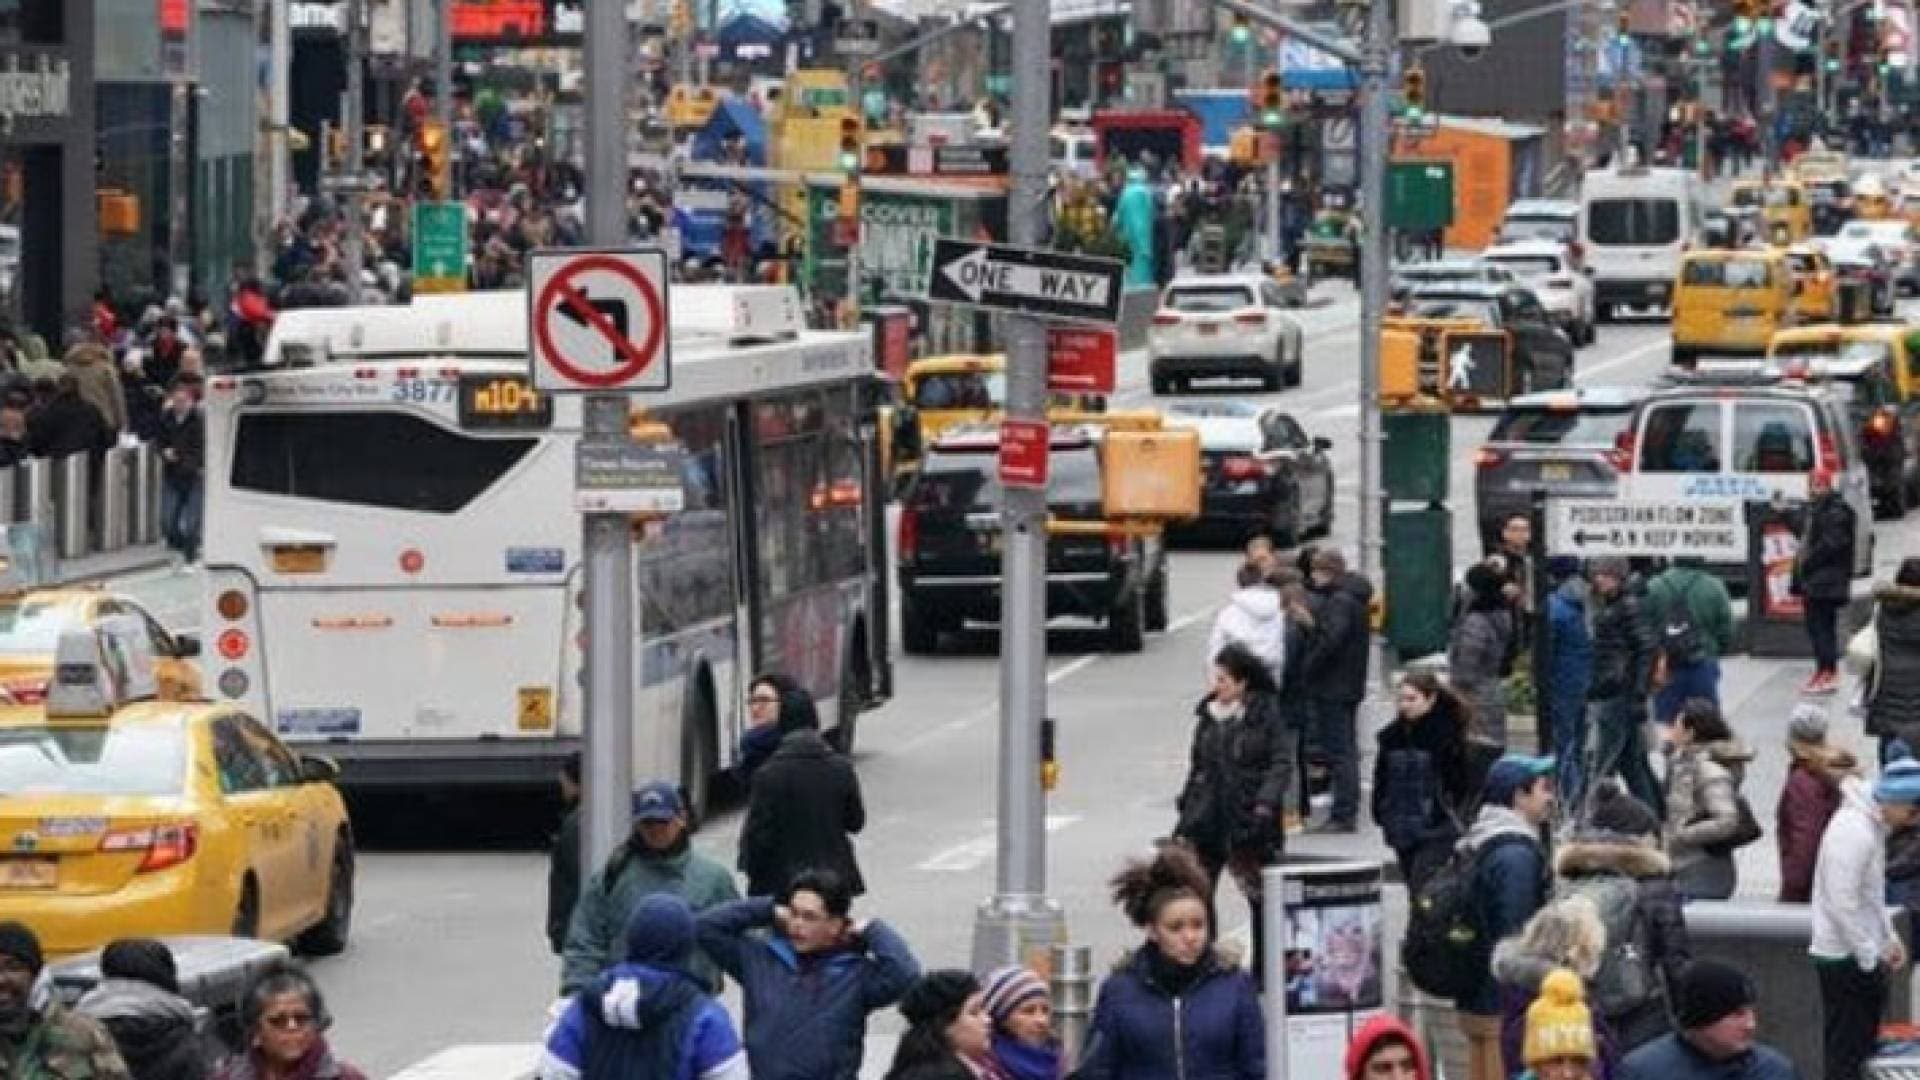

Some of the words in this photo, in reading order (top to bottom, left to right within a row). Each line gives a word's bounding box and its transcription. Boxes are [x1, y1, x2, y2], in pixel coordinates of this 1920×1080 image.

[959, 261, 1013, 290] ONE
[1040, 270, 1098, 301] WAY
[391, 379, 455, 402] 3877
[1570, 506, 1655, 524] PEDESTRIAN
[1658, 506, 1695, 524] FLOW
[1683, 529, 1735, 548] MOVING
